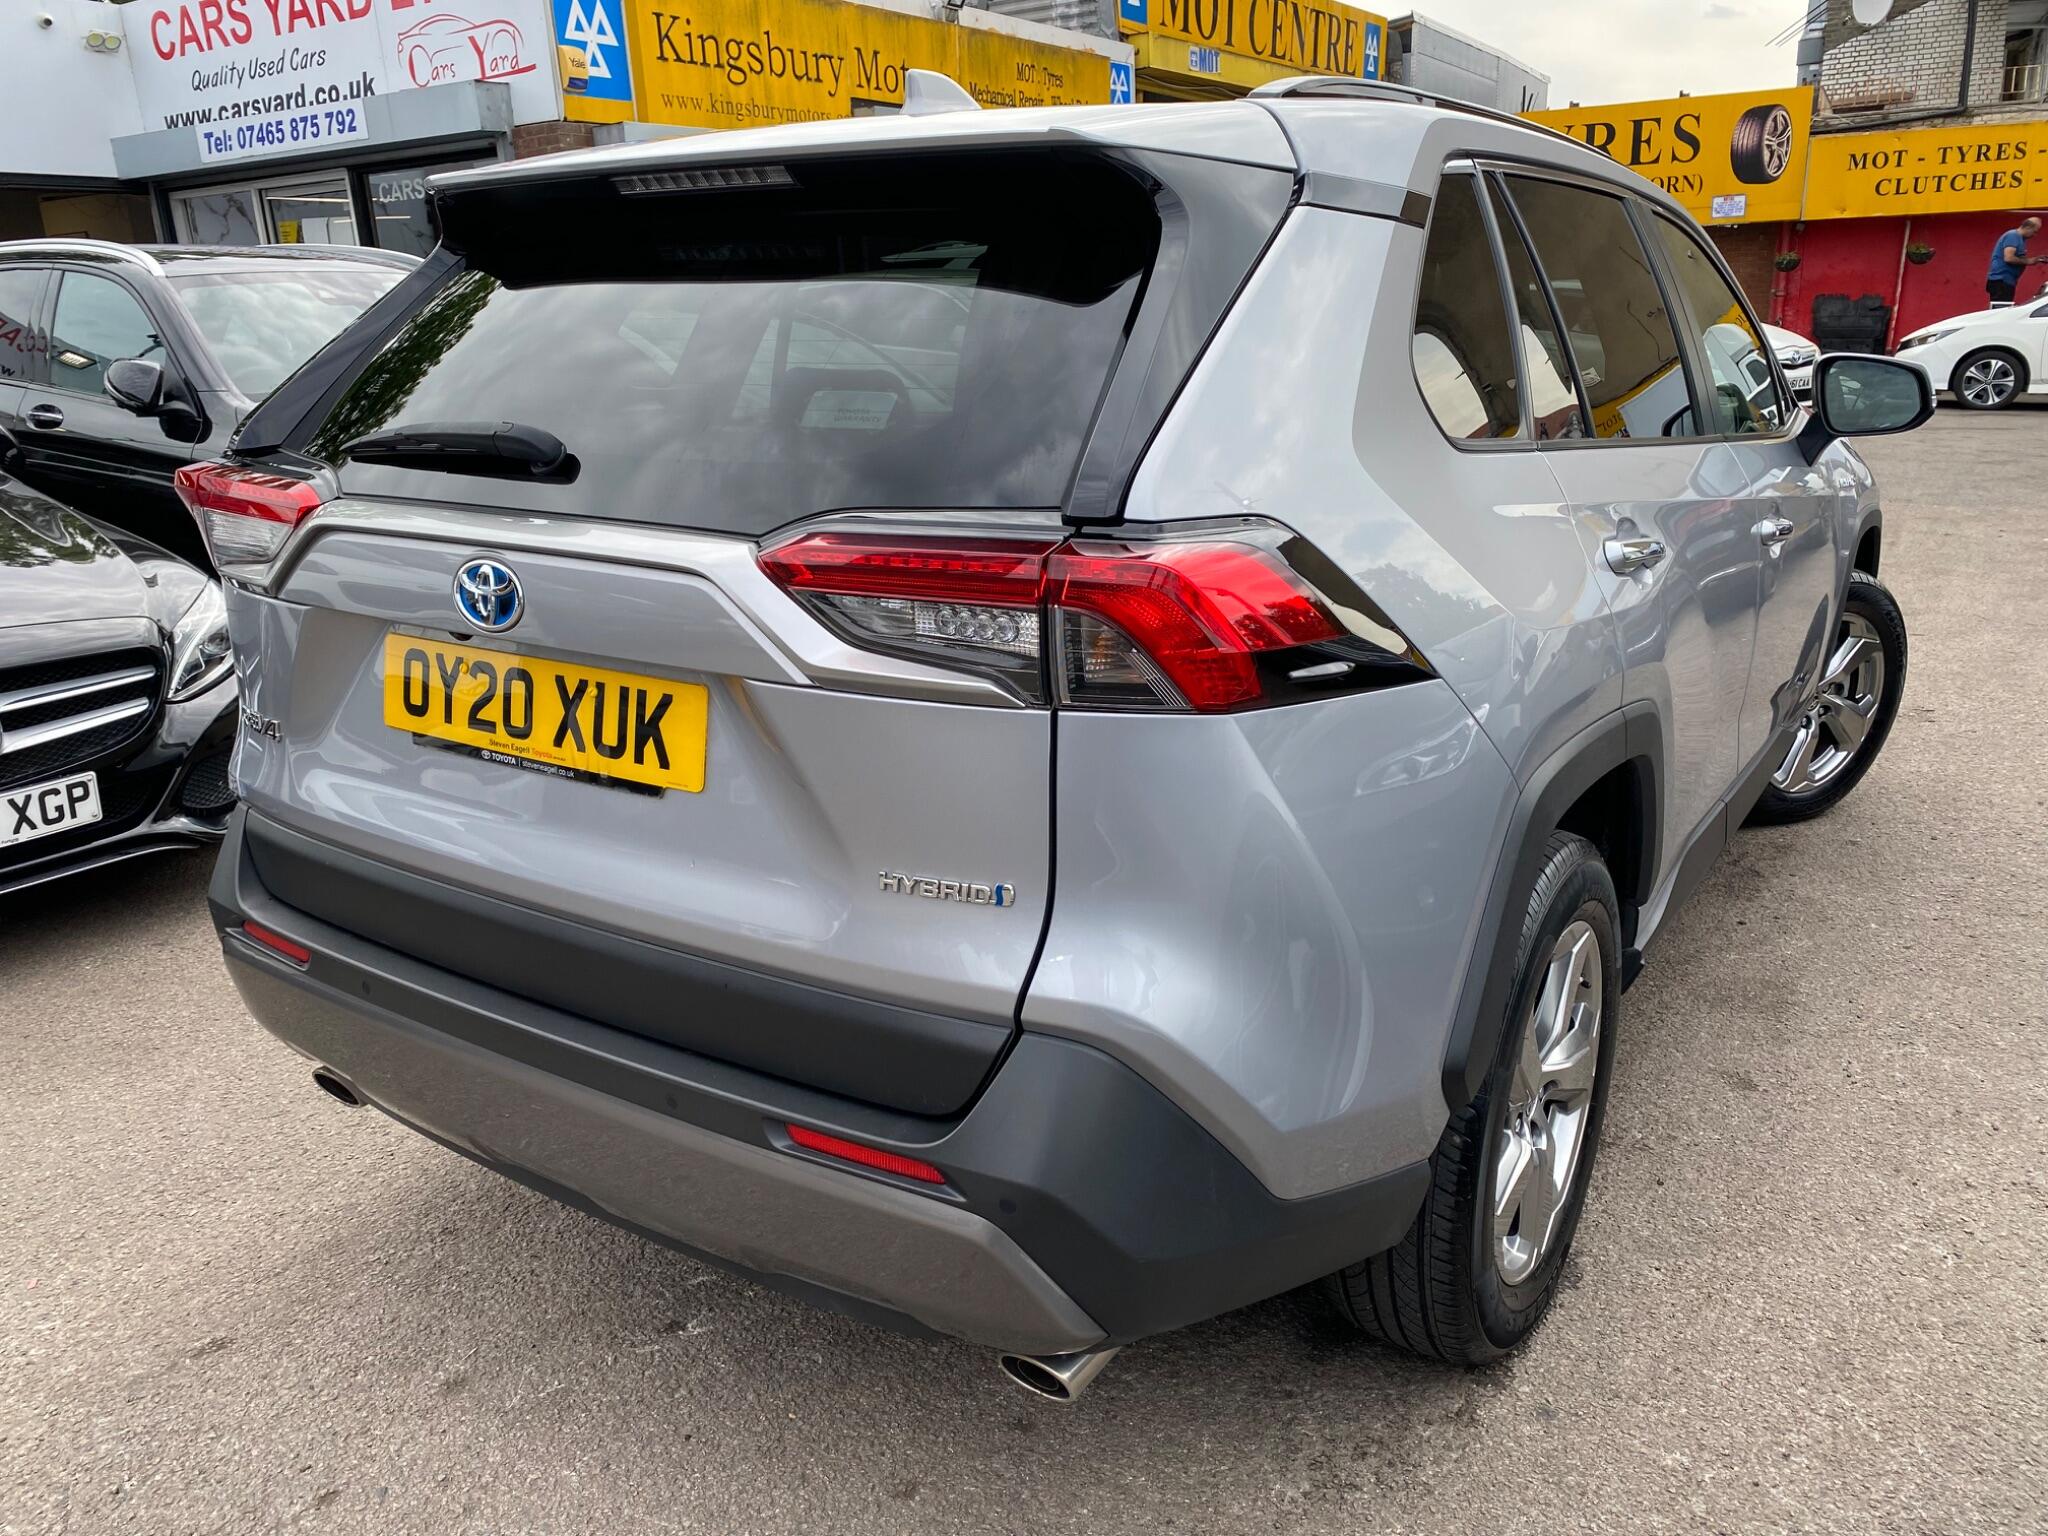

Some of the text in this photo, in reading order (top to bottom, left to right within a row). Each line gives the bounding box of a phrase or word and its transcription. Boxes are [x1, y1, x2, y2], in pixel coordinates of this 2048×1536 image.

[151, 0, 253, 61] CARS
[1160, 0, 1358, 76] MOT CENTRE
[191, 47, 327, 92] Quality Used Cars
[408, 28, 524, 88] Cars Yard
[569, 57, 587, 69] Yale
[652, 12, 910, 97] Kingsbury Mot
[1199, 47, 1220, 73] MOT
[1016, 62, 1036, 82] MOT
[1043, 67, 1064, 91] Tyres
[969, 81, 1017, 107] Mechanical
[204, 107, 358, 155] Tel: 07465 875 792
[1848, 149, 1908, 171] MOT
[1937, 141, 2028, 165] TYRES
[379, 178, 426, 203] CARS
[1651, 174, 1704, 196] ORN)
[1874, 169, 2024, 196] CLUTCHES
[402, 647, 674, 771] OY20 XUK
[489, 738, 511, 751] Steven
[511, 742, 531, 755] Eagell
[491, 752, 517, 766] TOYOTA
[7, 780, 91, 836] XGP
[878, 871, 992, 906] HYBRID
